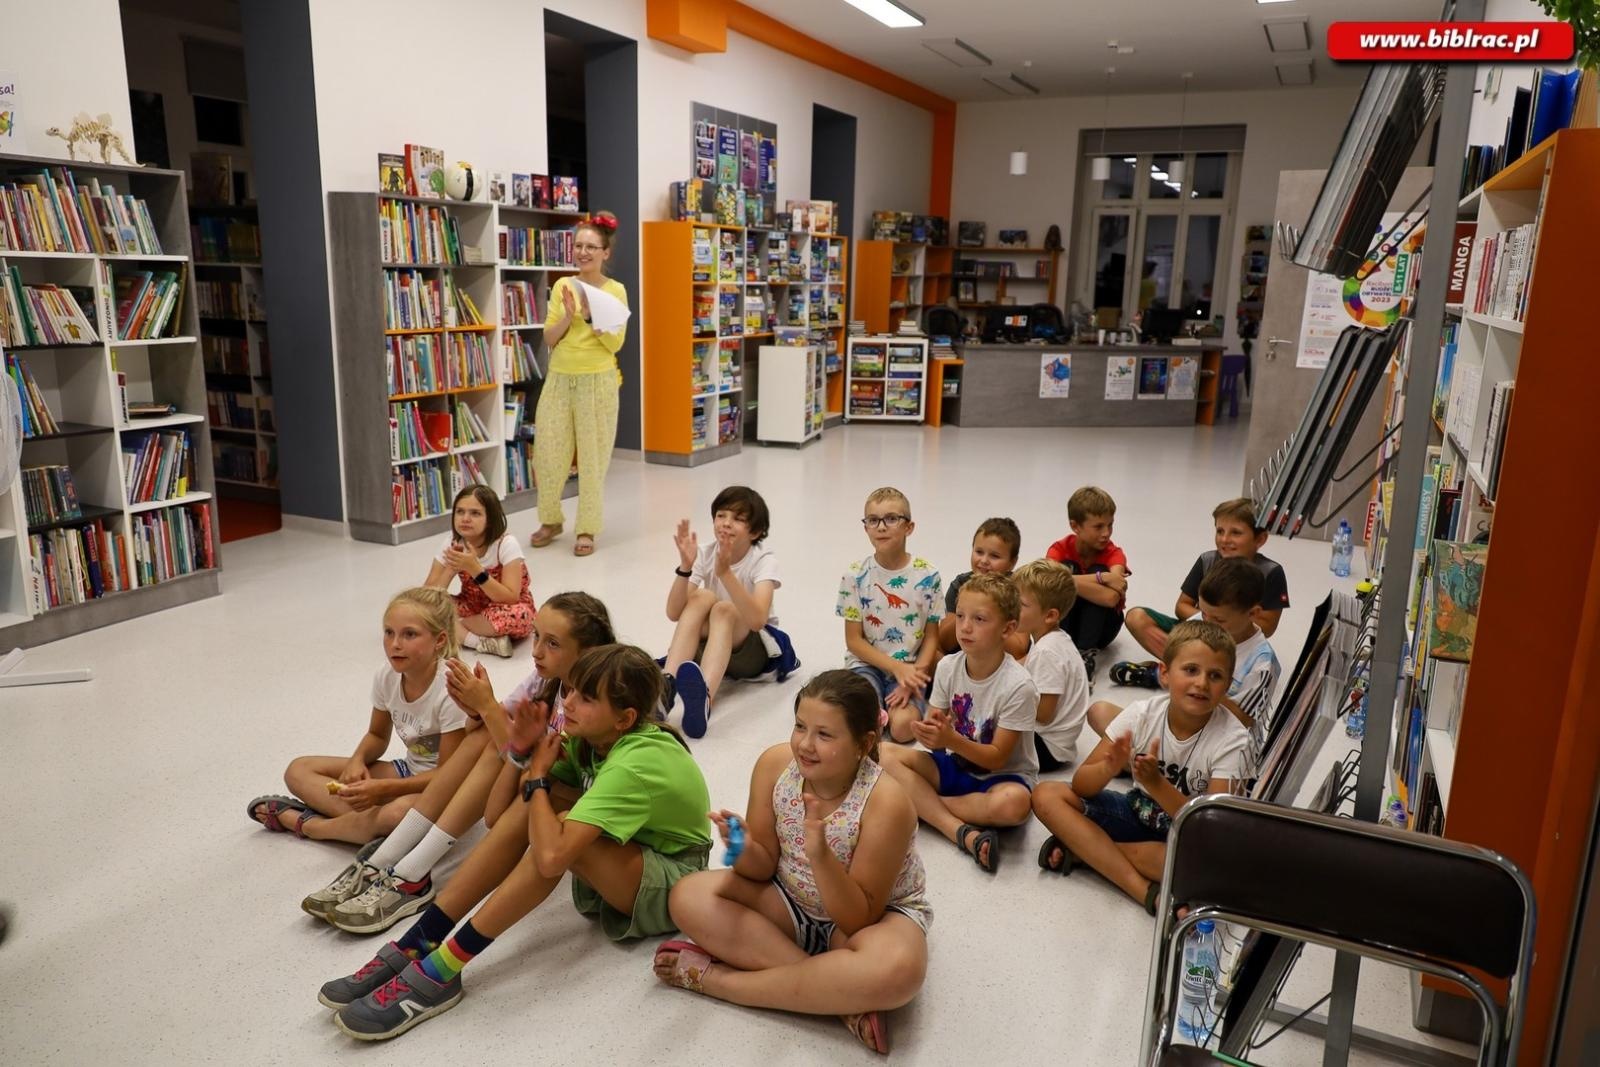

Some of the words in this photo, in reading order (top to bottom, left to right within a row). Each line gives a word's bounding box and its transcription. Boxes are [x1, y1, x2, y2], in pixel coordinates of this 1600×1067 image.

[1397, 256, 1407, 272] LAT
[1450, 235, 1473, 291] MANGA
[1420, 489, 1431, 536] KOMIKSY
